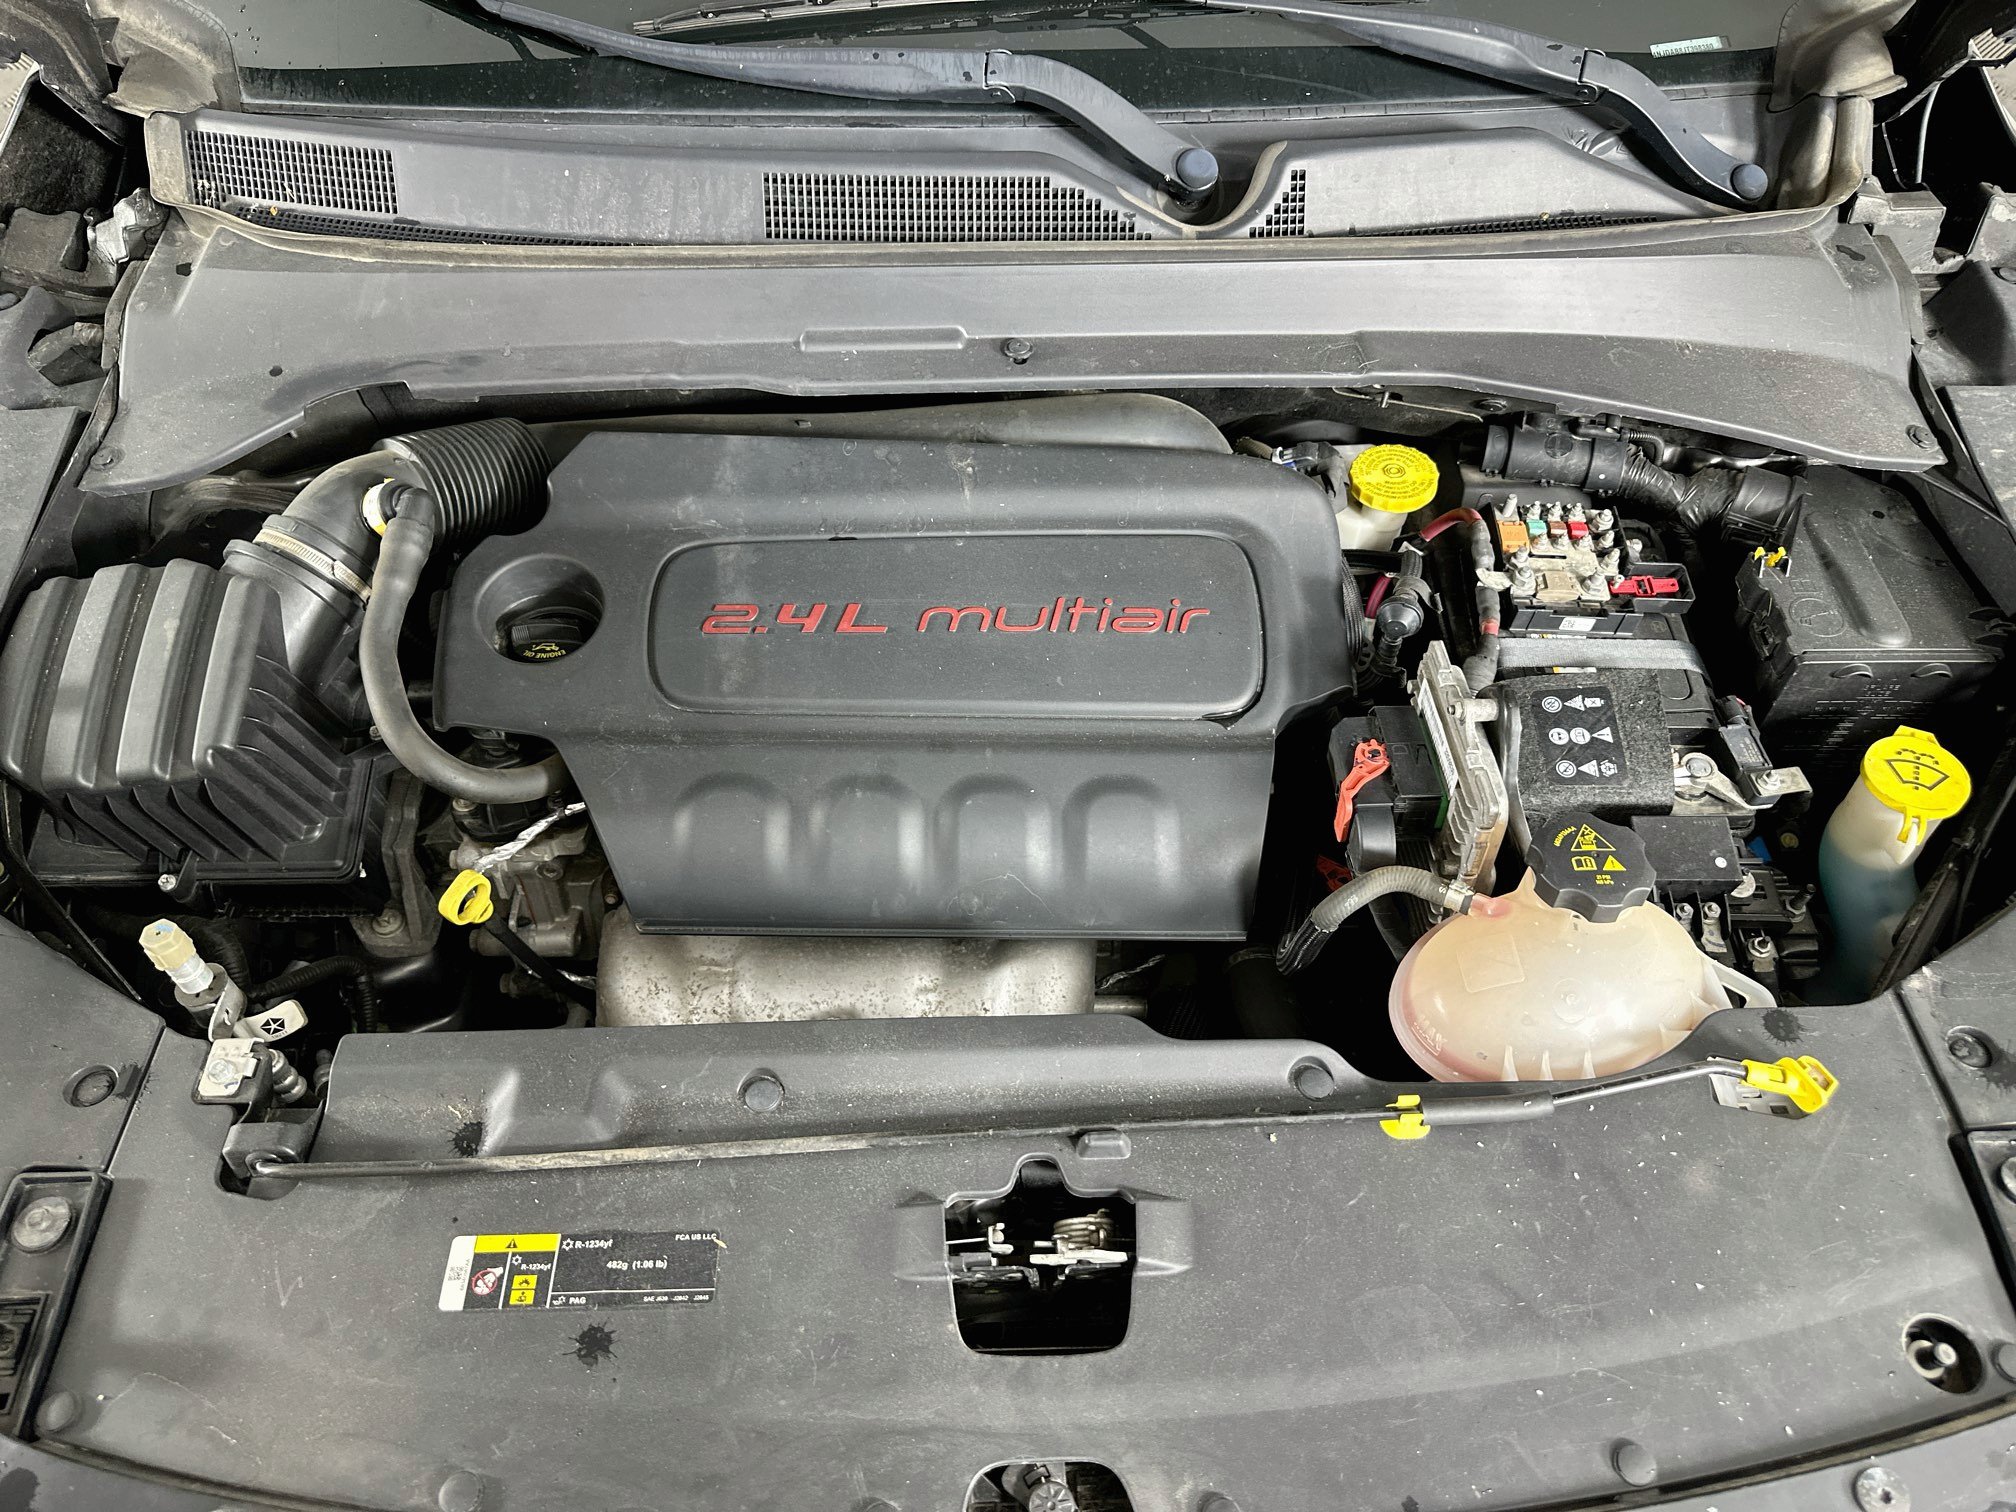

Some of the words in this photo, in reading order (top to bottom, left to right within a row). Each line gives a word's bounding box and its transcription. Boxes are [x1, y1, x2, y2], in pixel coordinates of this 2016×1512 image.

[917, 597, 1211, 634] multiair
[523, 650, 535, 659] OIL
[535, 650, 566, 659] ENGINE
[675, 1233, 690, 1241] FCA
[691, 1233, 702, 1241] US
[703, 1233, 717, 1241] LLC
[574, 1239, 613, 1251] R-1234yf
[520, 1262, 551, 1272] R-1234yf
[606, 1260, 628, 1271] 482g
[632, 1259, 653, 1270] (1.06
[655, 1258, 668, 1269] lb)
[569, 1296, 586, 1305] PAG
